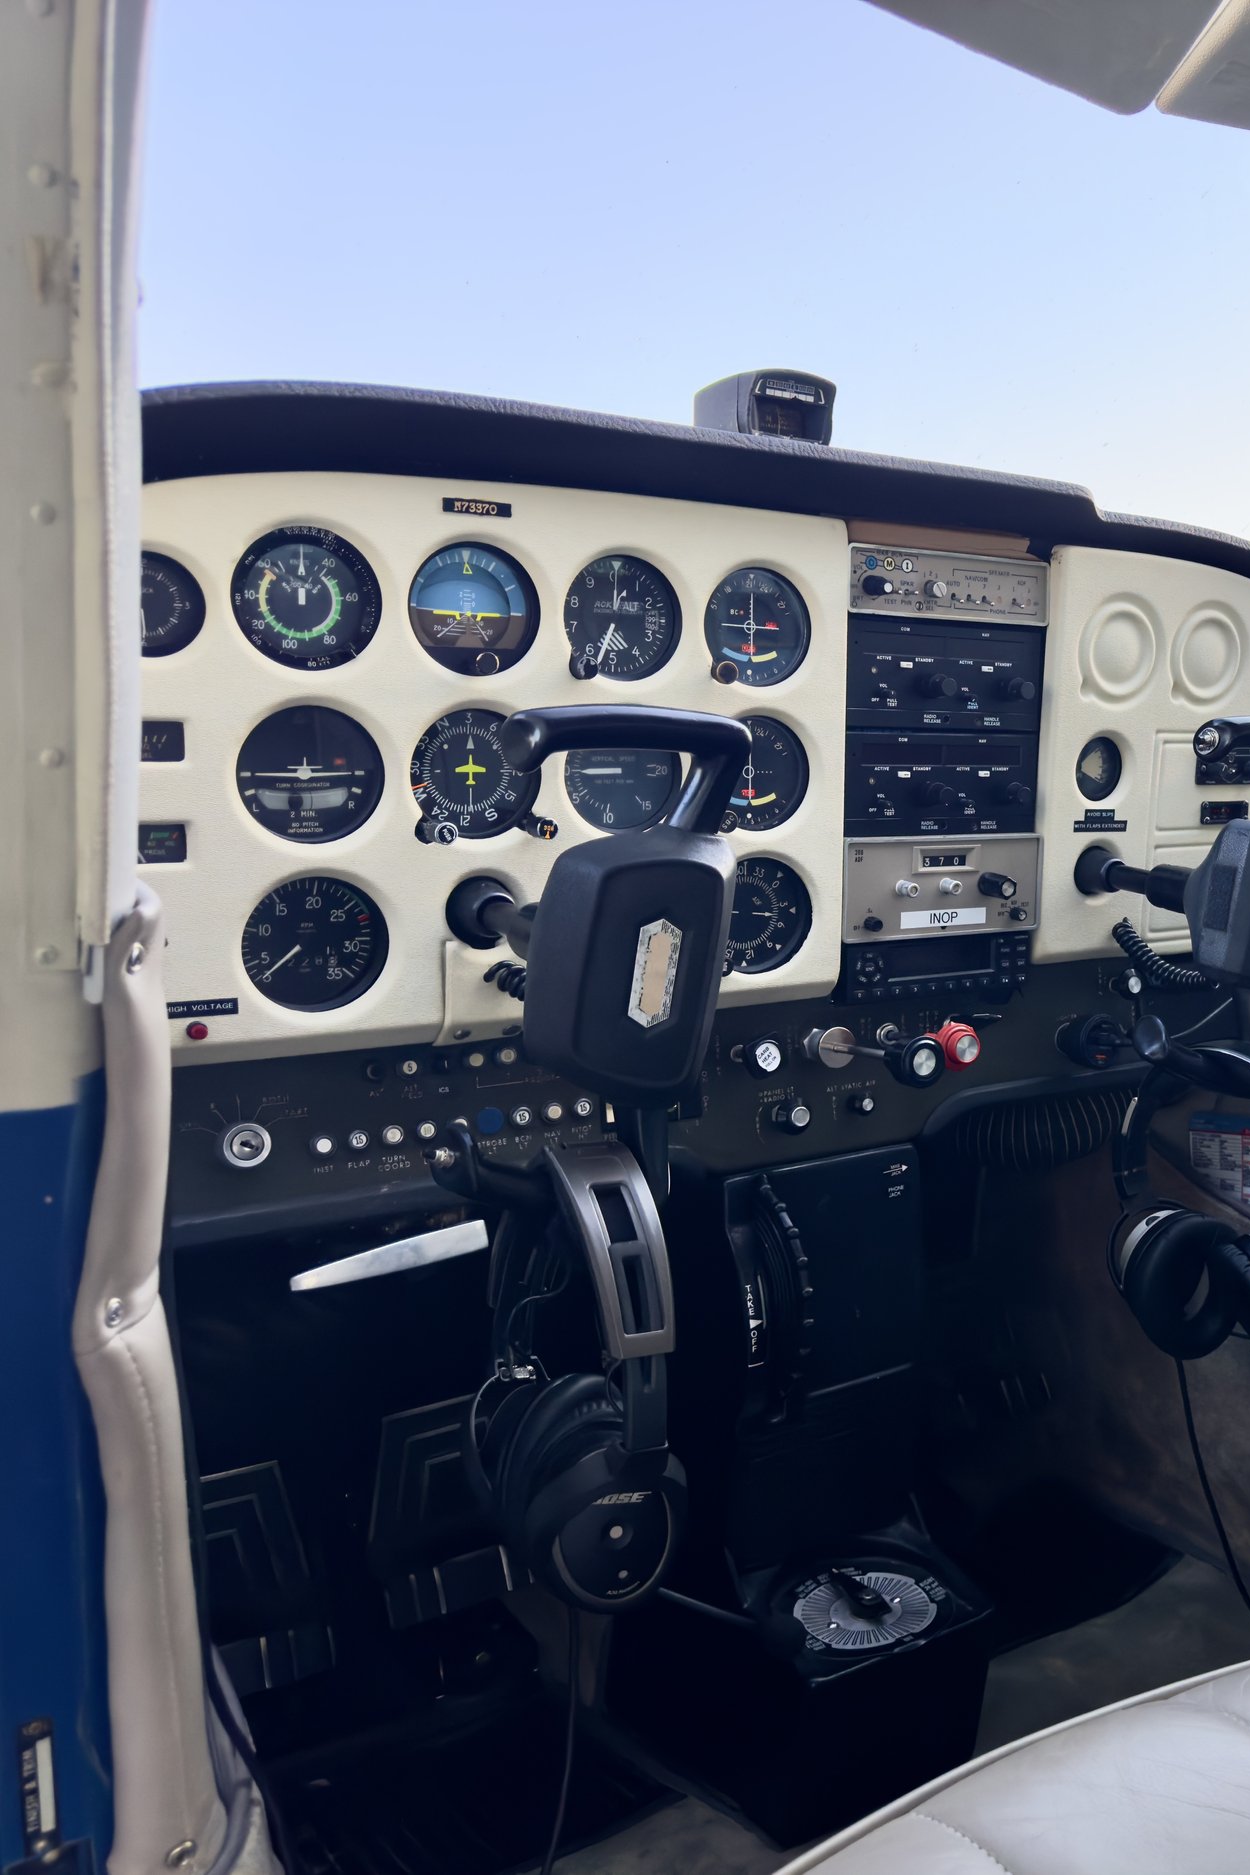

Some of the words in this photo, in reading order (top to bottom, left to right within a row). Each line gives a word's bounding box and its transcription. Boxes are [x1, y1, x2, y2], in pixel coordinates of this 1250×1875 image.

[454, 501, 497, 514] N73370
[322, 559, 335, 568] 40
[887, 560, 893, 568] M
[586, 577, 594, 588] 9
[346, 593, 358, 602] 60
[571, 596, 579, 607] 8
[646, 597, 652, 609] 2
[570, 621, 577, 632] 7
[324, 636, 336, 645] 80
[645, 630, 652, 642] 3
[282, 640, 297, 649] 100
[586, 644, 594, 655] 6
[632, 646, 640, 657] 4
[609, 653, 616, 664] 5
[435, 717, 450, 730] N
[465, 712, 472, 724] 3
[490, 722, 498, 732] 6
[417, 735, 429, 750] 33
[410, 760, 420, 775] 30
[655, 766, 668, 775] 20
[413, 787, 427, 802] W
[504, 790, 517, 801] 15
[572, 793, 580, 804] 5
[252, 803, 259, 812] L
[348, 801, 355, 809] R
[642, 801, 652, 811] 15
[431, 805, 449, 821] 24
[485, 808, 498, 821] S
[603, 813, 614, 824] 10
[460, 815, 470, 826] 21
[924, 858, 930, 867] 3
[939, 857, 944, 866] 7
[954, 857, 959, 865] 0
[753, 867, 765, 878] 33
[305, 896, 322, 909] 20
[275, 903, 288, 916] 15
[330, 910, 345, 922] 25
[930, 911, 958, 924] INOP
[259, 924, 271, 936] 10
[343, 941, 359, 952] 30
[261, 952, 270, 964] 5
[745, 949, 755, 959] 12
[327, 968, 343, 980] 35
[191, 1002, 234, 1011] VOLTAGE
[757, 1046, 769, 1059] CARB
[762, 1051, 772, 1063] HEAT
[408, 1063, 412, 1072] 5
[764, 1088, 784, 1097] PANEL
[764, 1095, 785, 1103] RADIO
[580, 1104, 588, 1112] 15
[519, 1113, 526, 1122] 15
[355, 1135, 364, 1145] 15
[515, 1136, 532, 1144] BCN
[544, 1131, 560, 1140] NAV
[477, 1138, 507, 1149] STROBE
[348, 1160, 370, 1169] FLAP
[382, 1155, 405, 1164] TURN
[378, 1162, 410, 1172] COORD
[888, 1184, 904, 1192] PHONE
[745, 1285, 755, 1316] TAKE
